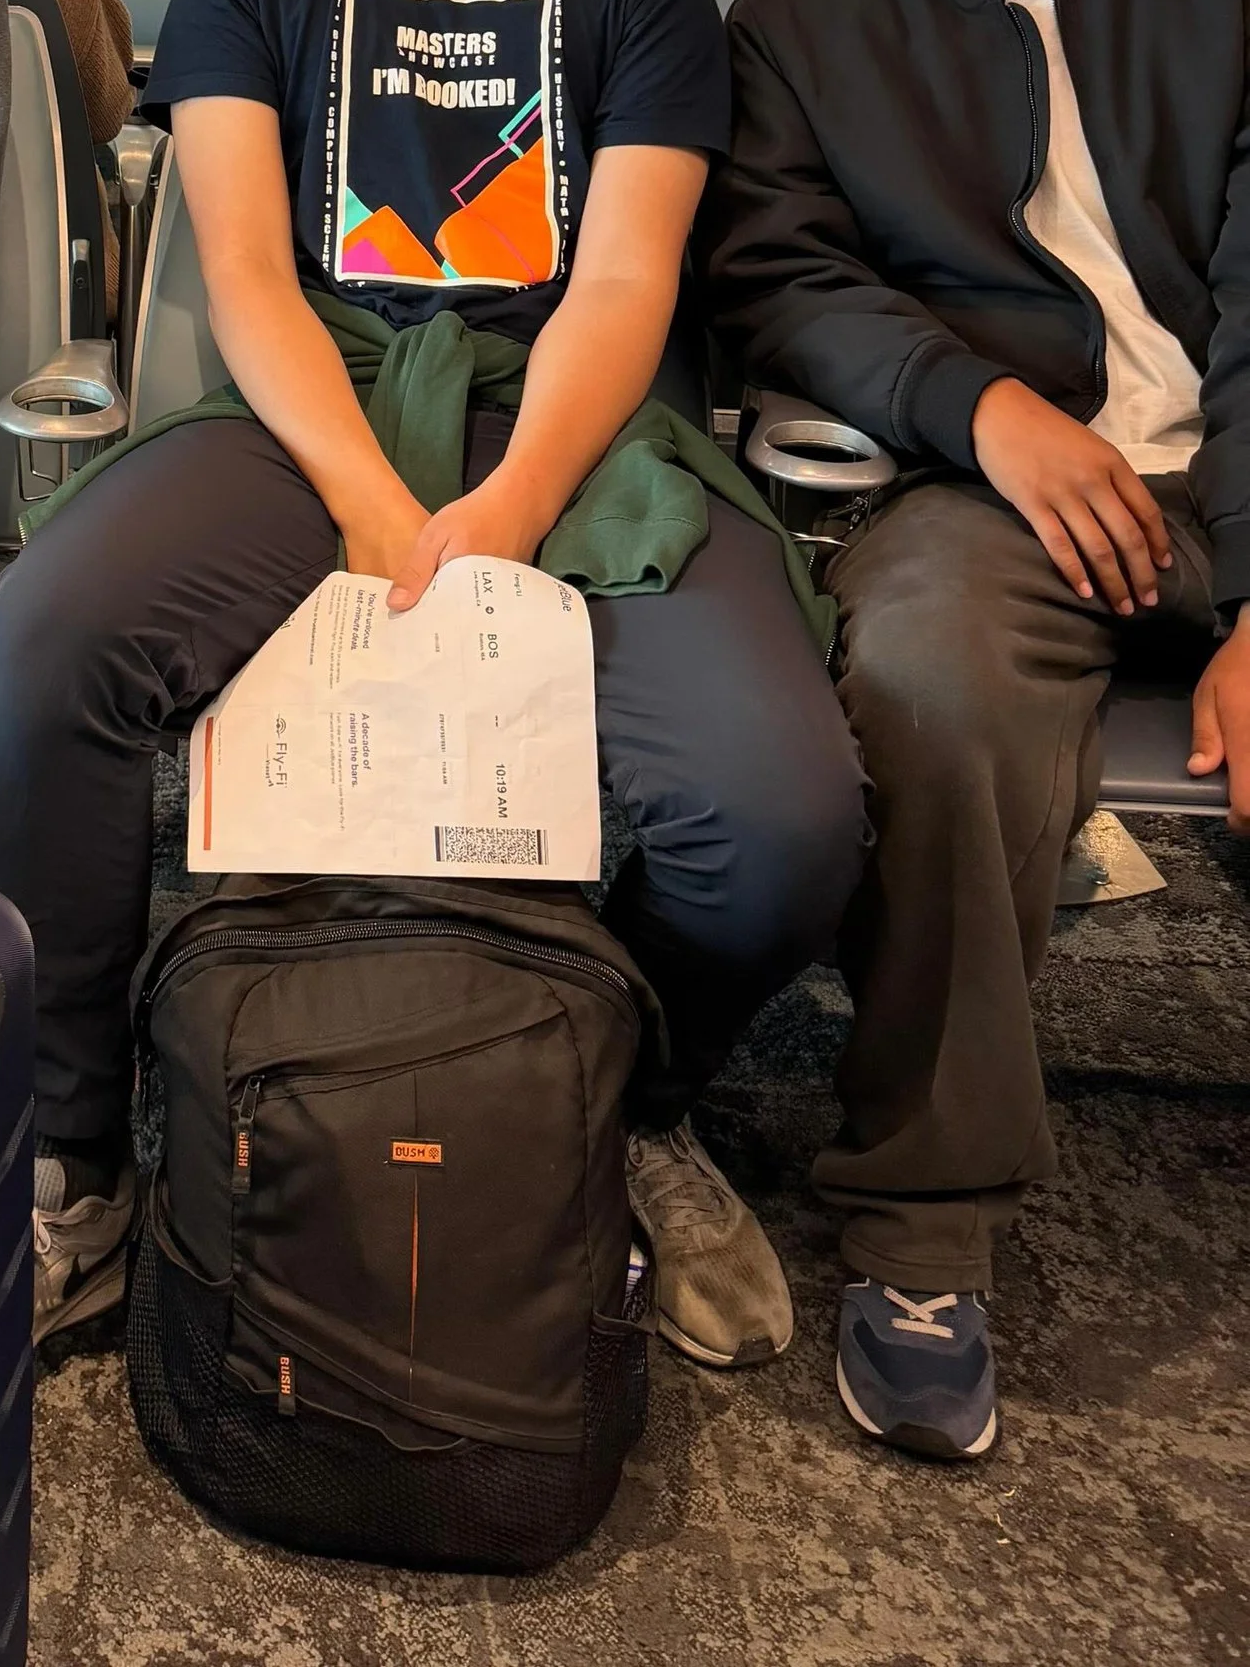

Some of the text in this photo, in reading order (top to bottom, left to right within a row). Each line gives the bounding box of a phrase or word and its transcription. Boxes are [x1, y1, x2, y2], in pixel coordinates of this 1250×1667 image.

[330, 29, 339, 83] BIBLE
[396, 25, 497, 56] MASTERS
[372, 67, 516, 109] I'M BOOKED!
[554, 73, 565, 152] HISTORY
[325, 106, 336, 195] COMPUTER
[559, 175, 569, 216] MATH
[322, 213, 332, 273] SCIENC
[353, 590, 365, 632] last-minute
[362, 594, 377, 649] You've unlocked
[482, 571, 508, 819] LAX BOS 10:19 AM
[348, 713, 359, 788] raising the bars.
[362, 722, 370, 758] decade
[273, 742, 288, 785] Fly-Fi
[363, 759, 371, 770] of
[239, 1131, 250, 1167] BUSH
[395, 1146, 426, 1159] BUSH
[279, 1356, 292, 1395] BUSH
